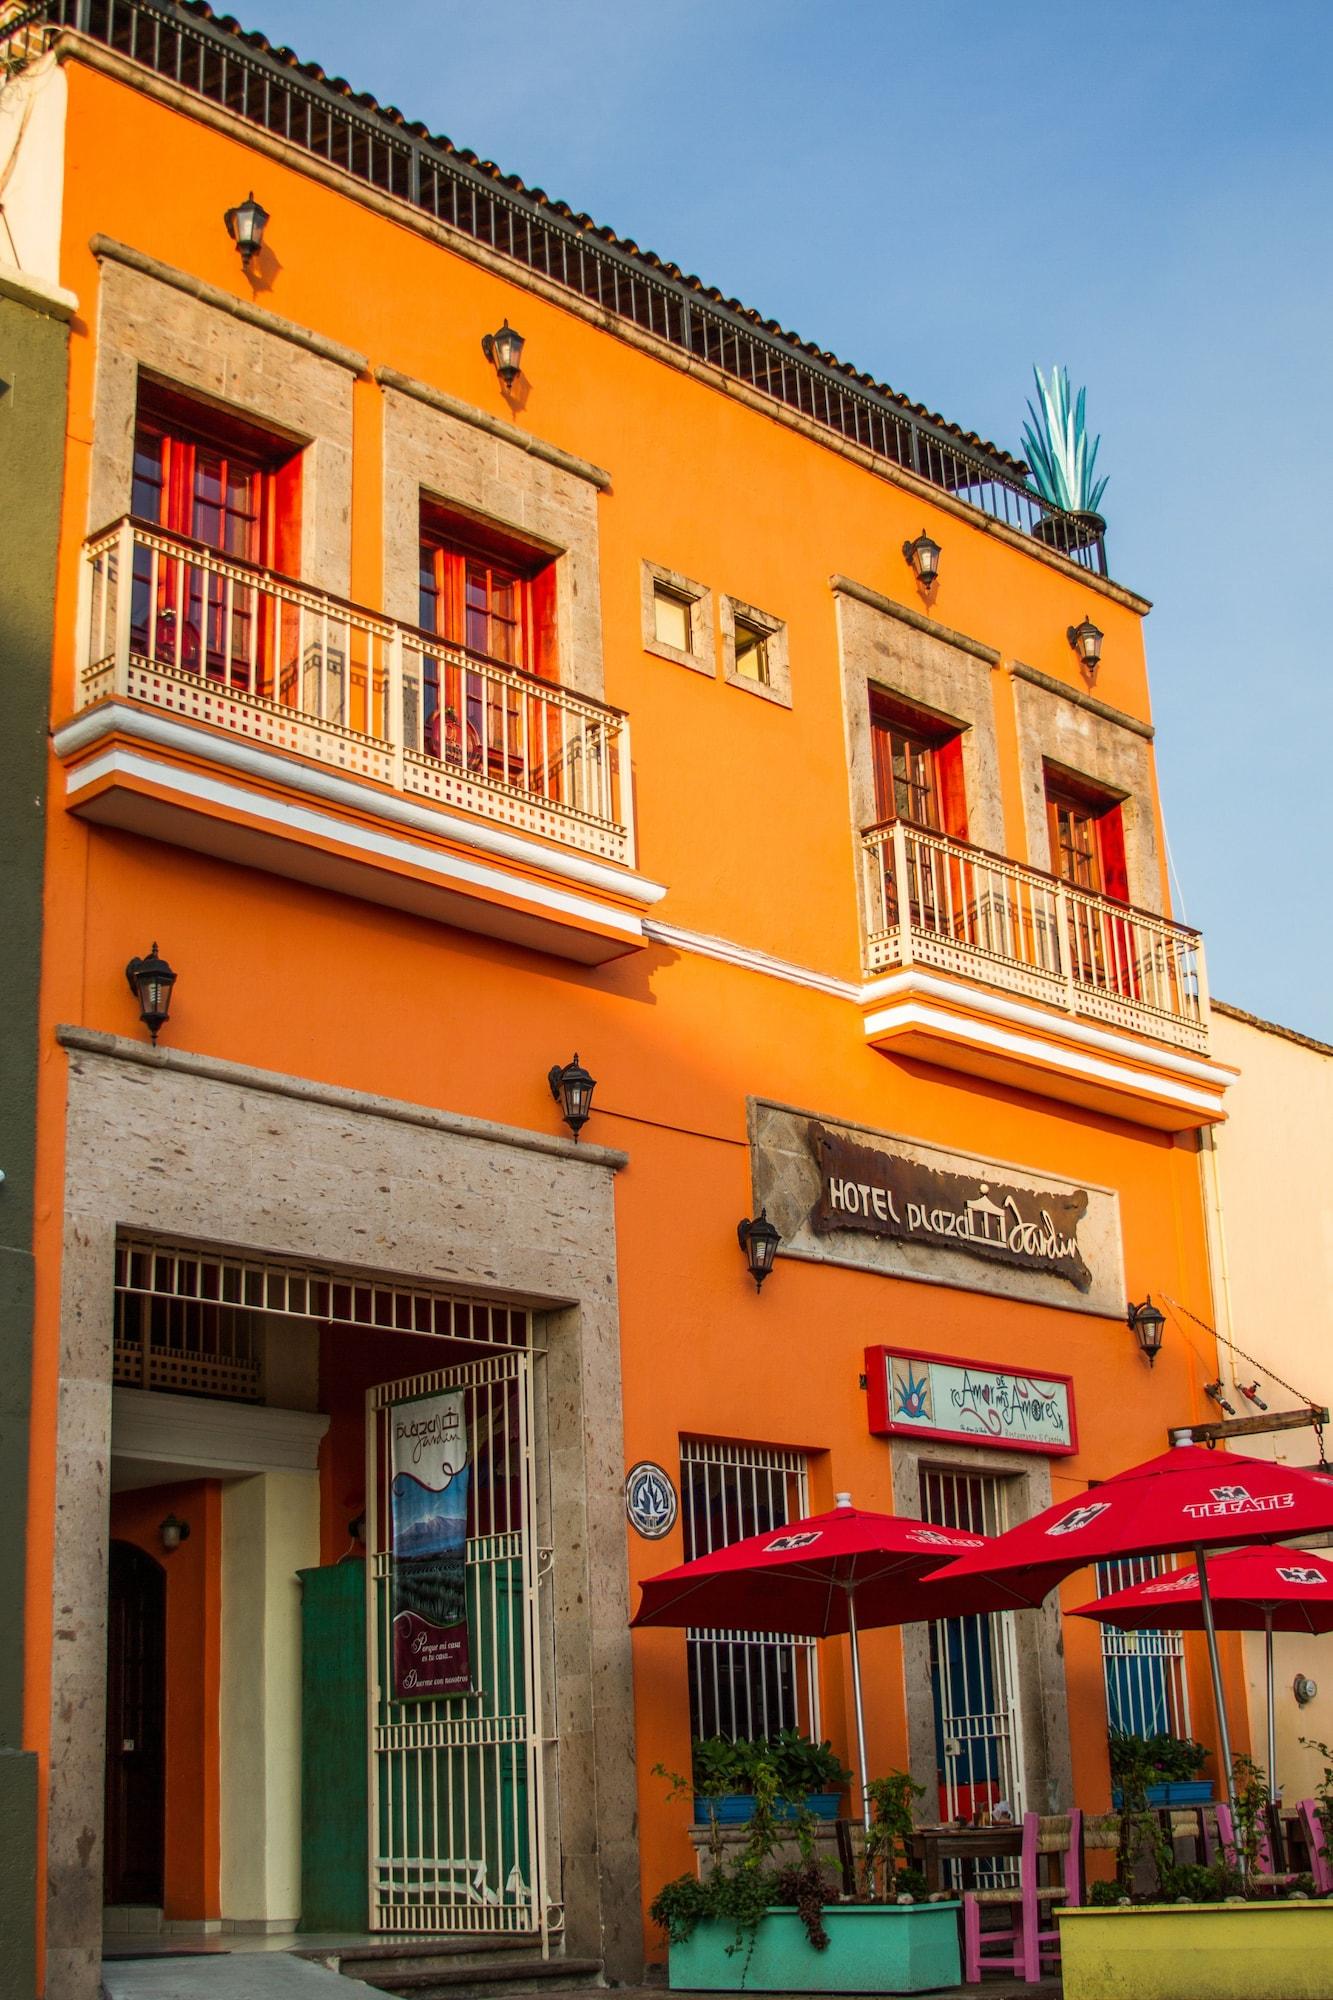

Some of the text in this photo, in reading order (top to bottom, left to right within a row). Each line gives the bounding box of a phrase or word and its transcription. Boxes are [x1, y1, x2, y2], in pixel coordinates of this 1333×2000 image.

[830, 1177, 900, 1223] HOTEL
[906, 1203, 969, 1239] plaza
[1182, 1493, 1295, 1518] TECATE
